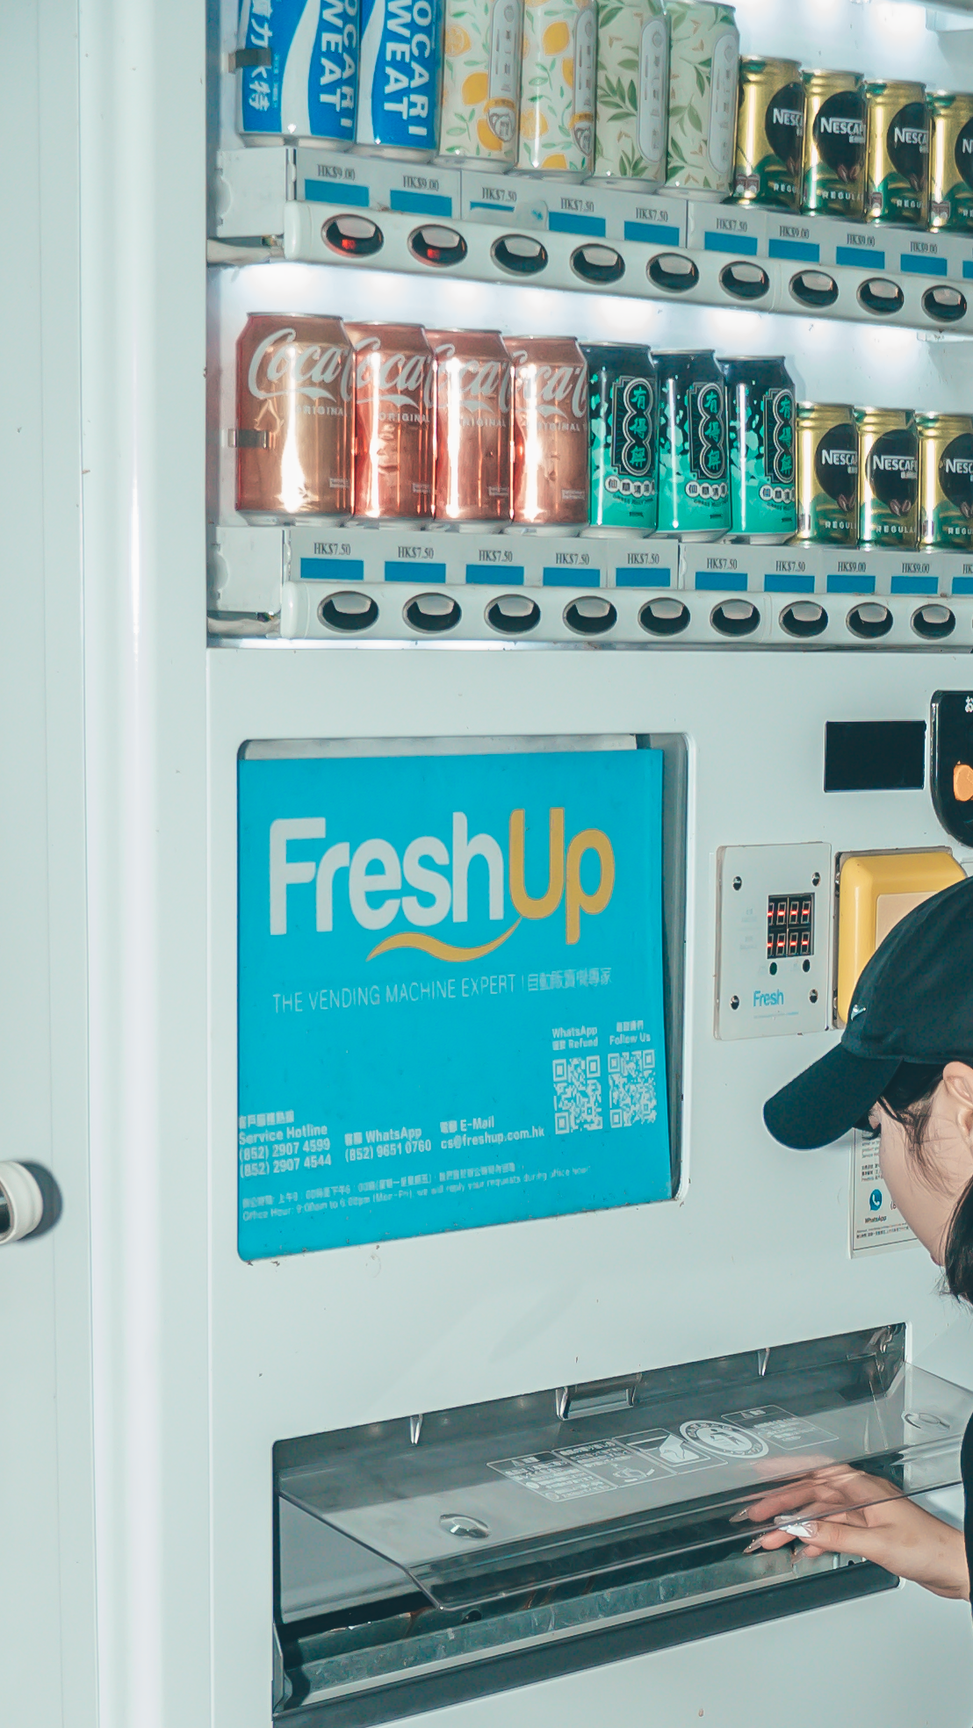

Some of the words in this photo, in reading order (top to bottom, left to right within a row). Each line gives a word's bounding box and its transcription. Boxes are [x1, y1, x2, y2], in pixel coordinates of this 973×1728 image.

[320, 0, 344, 112] WEAT
[384, 0, 412, 120] WEAT
[340, 0, 358, 128] OCARI
[408, 0, 432, 136] OCARI
[773, 108, 802, 126] NESC
[820, 116, 864, 135] NESCA
[894, 127, 929, 144] NESCA
[378, 412, 430, 423] ORIGINAL
[460, 418, 507, 428] RIGINAL
[531, 421, 581, 433] RIGINAL
[821, 449, 857, 465] NESCA
[825, 520, 857, 530] REGUL
[876, 524, 916, 534] REGULA
[313, 542, 351, 556] HK$7.50
[397, 545, 434, 559] HK$7.50
[478, 549, 513, 562] HK$7.50
[555, 552, 590, 565] HK$7.50
[627, 552, 660, 564] HK$7.50
[706, 557, 738, 570] HK$7.50
[775, 560, 806, 572] HK$7.50
[837, 561, 867, 573] HK$9.00
[901, 562, 930, 574] HK$9.00
[269, 807, 616, 945] FreshUp
[272, 992, 303, 1014] THE
[308, 985, 380, 1010] VENDING
[385, 978, 457, 1003] MACHINE
[461, 973, 517, 998] EXPERT
[552, 1025, 598, 1038] WhatsApp
[609, 1033, 638, 1046] Follow
[639, 1032, 651, 1043] Us
[568, 1037, 599, 1049] Refund
[460, 1115, 495, 1132] E-Mail
[239, 1130, 284, 1146] Service
[286, 1123, 328, 1140] Hotline
[365, 1127, 422, 1144] WhatsApp
[440, 1126, 545, 1150] cs@freshup.com.hk
[239, 1145, 270, 1162] (852)
[272, 1141, 300, 1158] 2907
[302, 1137, 331, 1153] 4599
[345, 1147, 374, 1163] (852)
[376, 1143, 402, 1158] 9651
[405, 1139, 432, 1154] 0760
[240, 1161, 270, 1178] (852)
[272, 1158, 300, 1174] 2907
[303, 1153, 332, 1169] 4544
